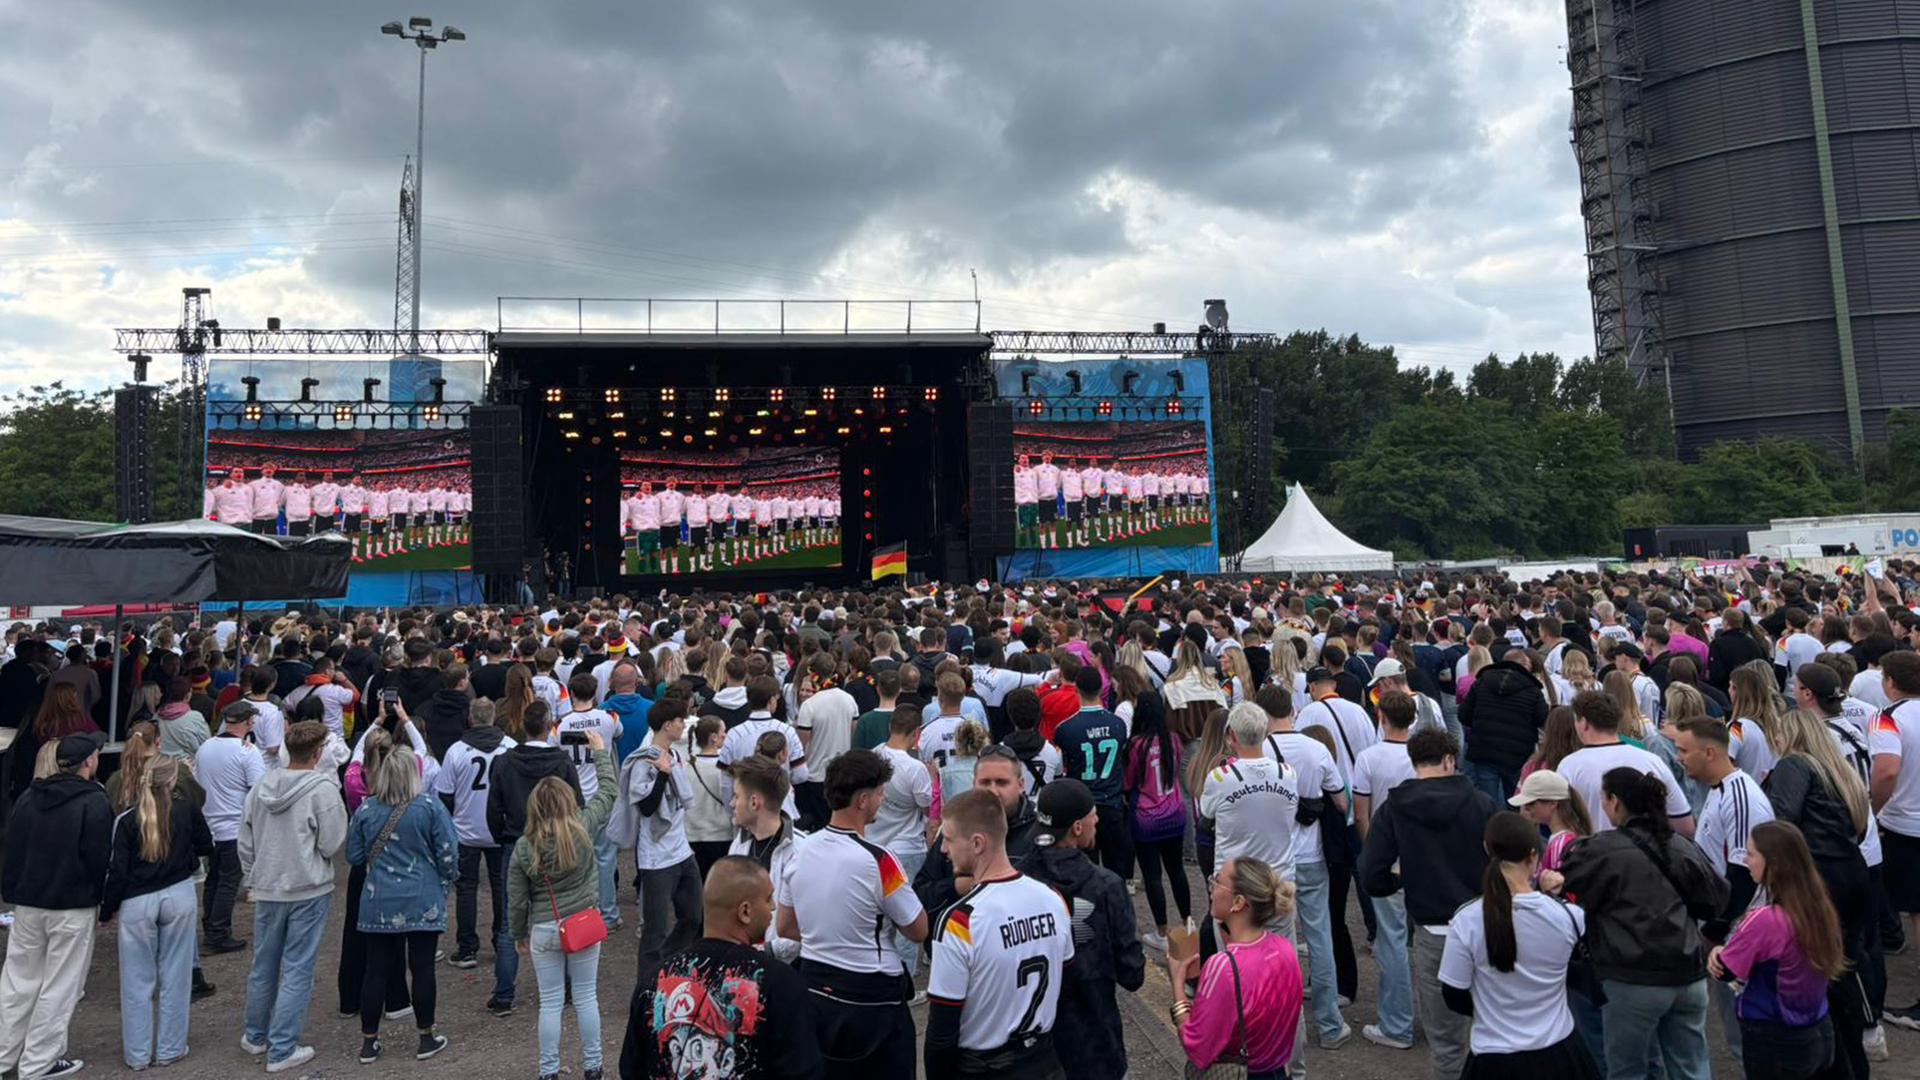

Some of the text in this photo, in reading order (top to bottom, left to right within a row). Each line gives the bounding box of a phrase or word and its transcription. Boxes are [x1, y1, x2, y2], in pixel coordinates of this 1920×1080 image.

[1892, 527, 1920, 547] PO
[569, 718, 601, 730] MUSIALA
[1086, 726, 1111, 739] WIRTZ
[1080, 738, 1119, 781] 17
[1226, 780, 1295, 804] Deutschland
[999, 913, 1057, 949] RÜDIGER
[673, 998, 690, 1012] M
